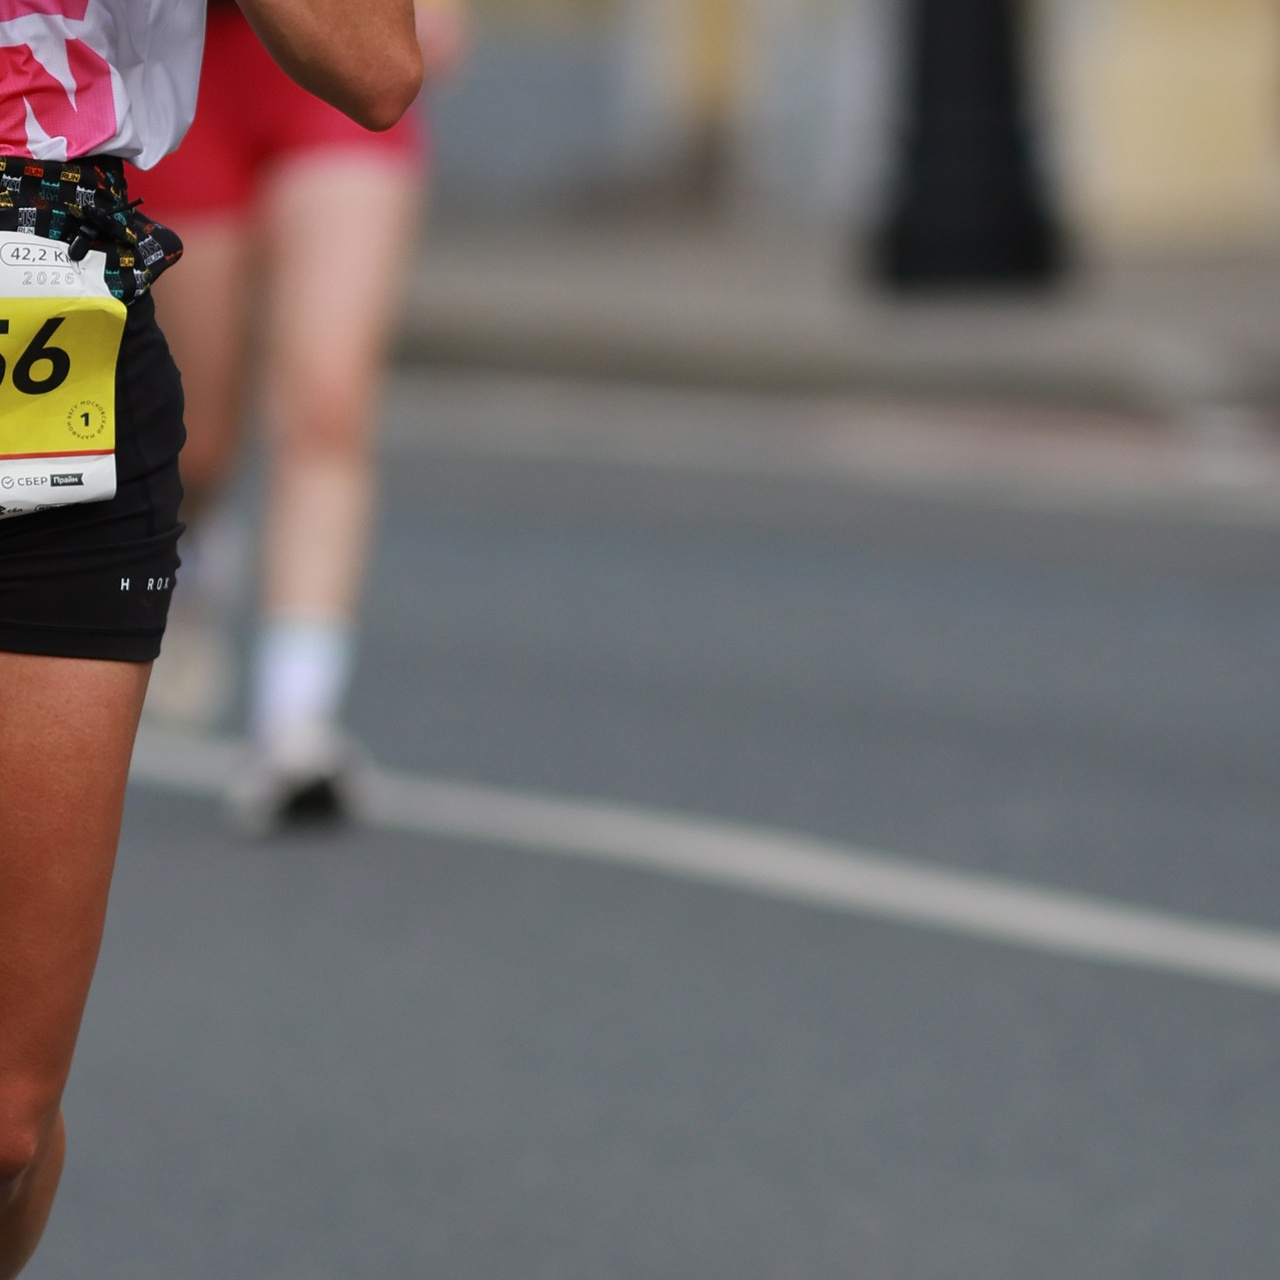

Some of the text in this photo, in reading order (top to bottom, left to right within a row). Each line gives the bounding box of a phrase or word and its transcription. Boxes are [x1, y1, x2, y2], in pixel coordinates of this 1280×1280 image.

[10, 247, 47, 263] 42,2
[80, 412, 89, 427] 1
[17, 475, 79, 487] СБЕР Прайм
